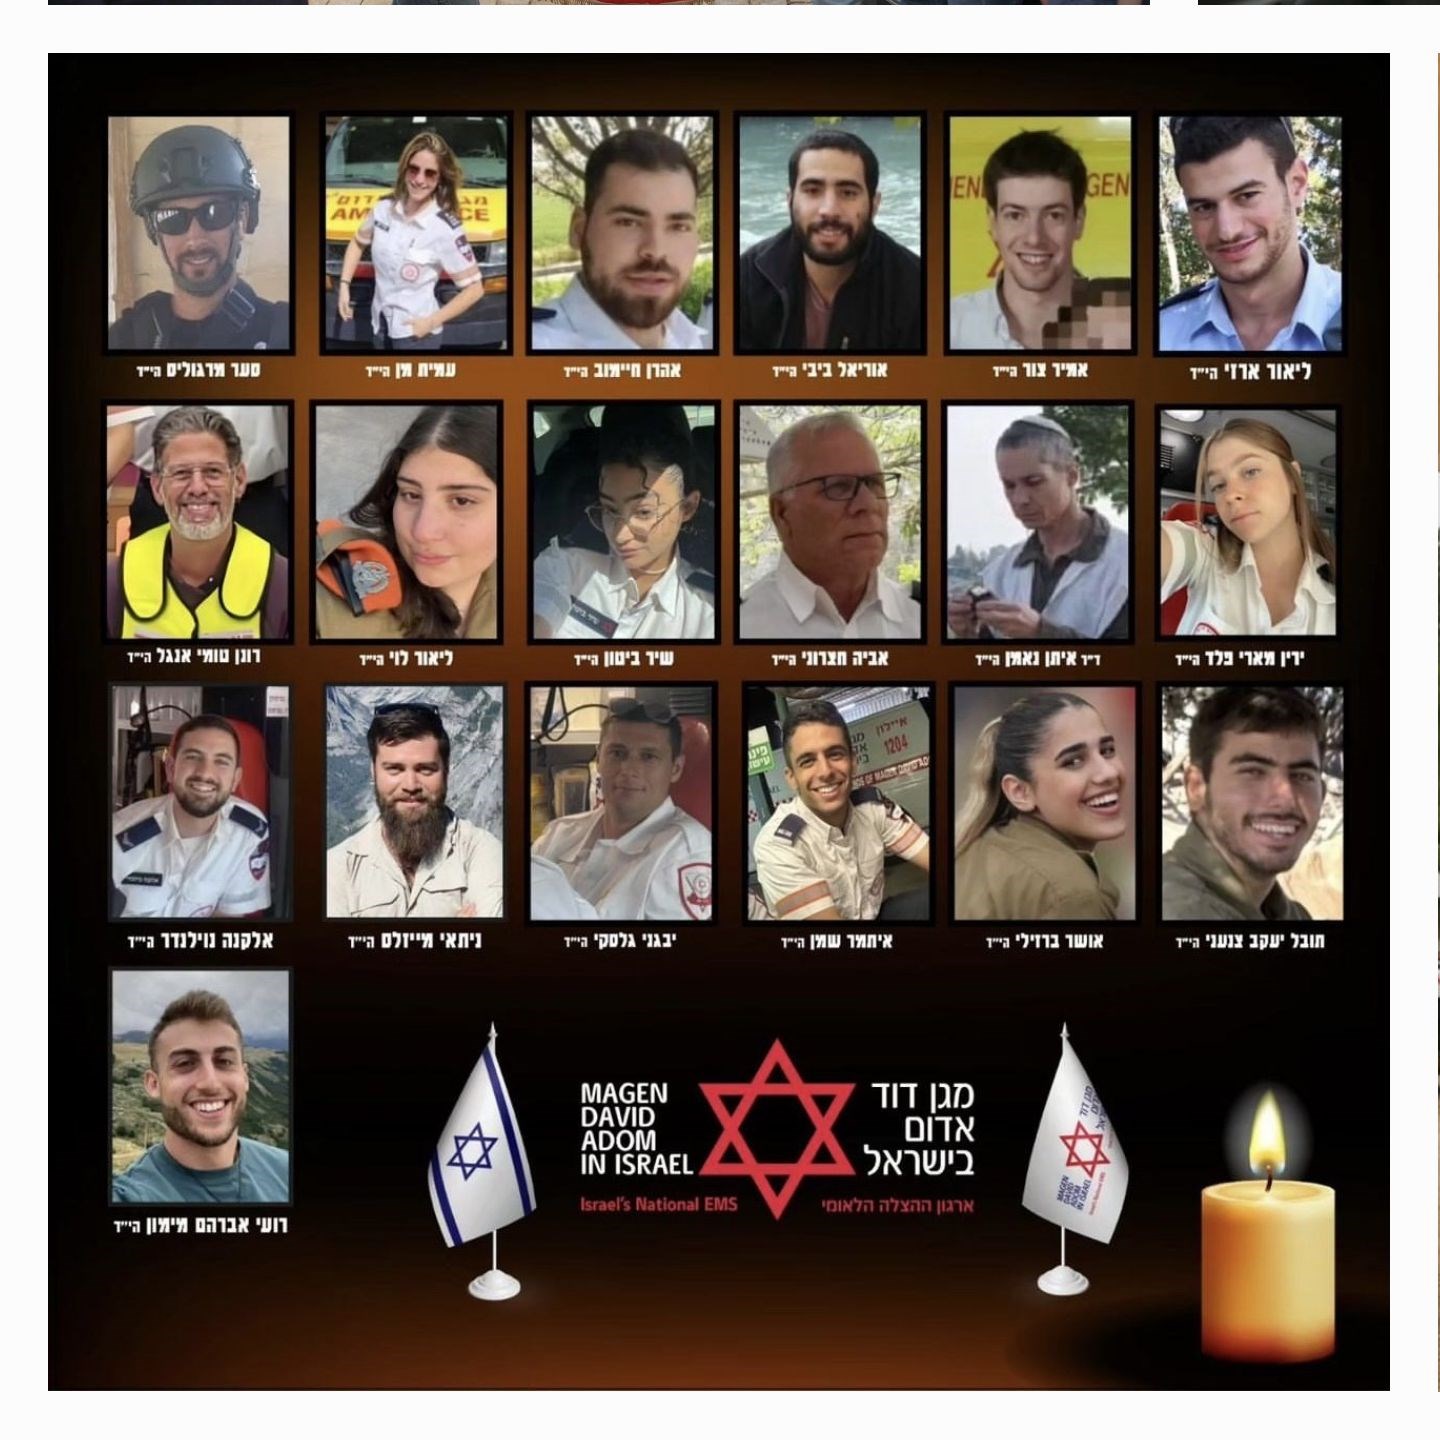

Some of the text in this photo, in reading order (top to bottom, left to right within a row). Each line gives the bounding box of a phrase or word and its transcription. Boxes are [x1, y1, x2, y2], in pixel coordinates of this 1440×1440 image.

[166, 361, 261, 378] סער מרגוליס
[395, 362, 456, 379] עמית מן
[593, 362, 682, 380] אהרן חיימוב
[802, 361, 888, 378] אוריאל ביבי
[1022, 362, 1089, 378] אמיר צור
[1224, 363, 1260, 380] ארזי
[1266, 361, 1312, 380] ליאור
[156, 647, 261, 666] רונן טומי אנגל
[389, 649, 454, 666] ליאור לוי
[603, 650, 674, 668] שיר ביטון
[801, 650, 889, 666] אביה חצרוני
[1005, 650, 1040, 668] נאמן
[1044, 650, 1077, 668] איתן
[1204, 649, 1305, 668] ירין מארי פלד
[883, 734, 909, 755] 1204
[160, 930, 274, 951] אלקנה נוילנדר
[381, 931, 482, 949] ניתאי מייזלס
[593, 931, 677, 950] יבגני גלסקי
[810, 933, 893, 951] איתמר שמן
[1015, 932, 1104, 949] אושר ברזילי
[1205, 932, 1325, 951] תובל יעקב צנעני
[581, 1082, 668, 1104] MAGEN
[871, 1082, 975, 1114] מגן דוד
[581, 1106, 656, 1128] DAVID
[904, 1116, 975, 1143] אדום
[581, 1129, 657, 1151] ADOM
[581, 1153, 694, 1175] IN ISRAEL
[863, 1144, 975, 1176] בישראל
[636, 1196, 699, 1212] National
[704, 1197, 738, 1212] EMS
[821, 1198, 975, 1214] ארגון ההצלה הלאומי
[146, 1217, 188, 1236] מימון
[195, 1217, 250, 1234] אברהם
[255, 1217, 288, 1234] רועי
